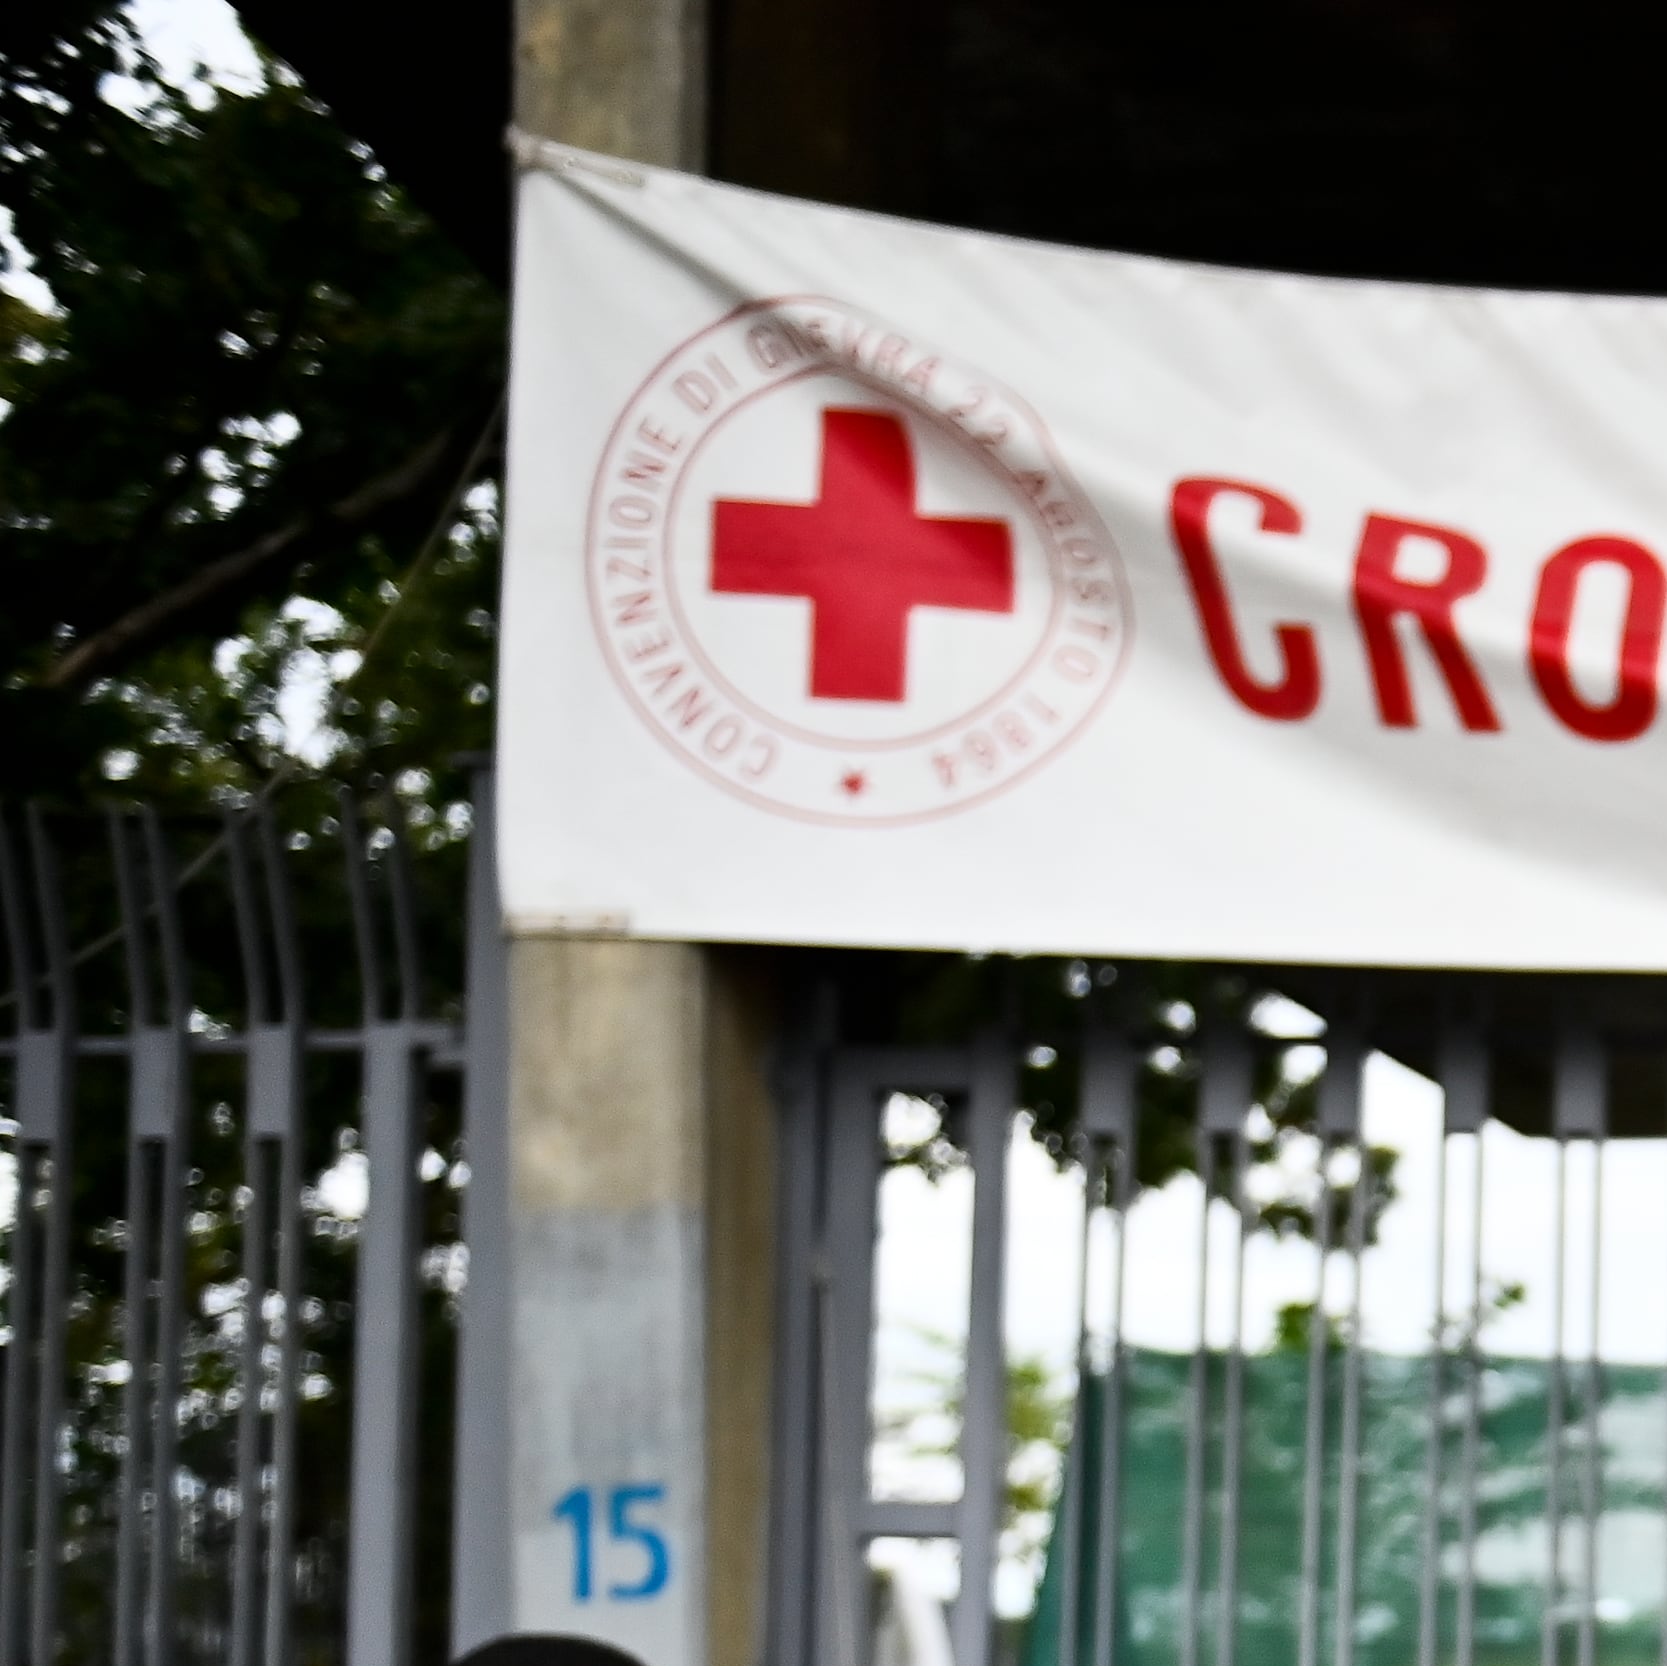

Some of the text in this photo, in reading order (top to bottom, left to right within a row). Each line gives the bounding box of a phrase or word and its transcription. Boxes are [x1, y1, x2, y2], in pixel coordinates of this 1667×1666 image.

[671, 350, 738, 413] DI
[743, 318, 940, 398] GVRA
[604, 415, 780, 780] CONVENZIONE
[929, 692, 1063, 790] 1864
[551, 1482, 671, 1604] 15
